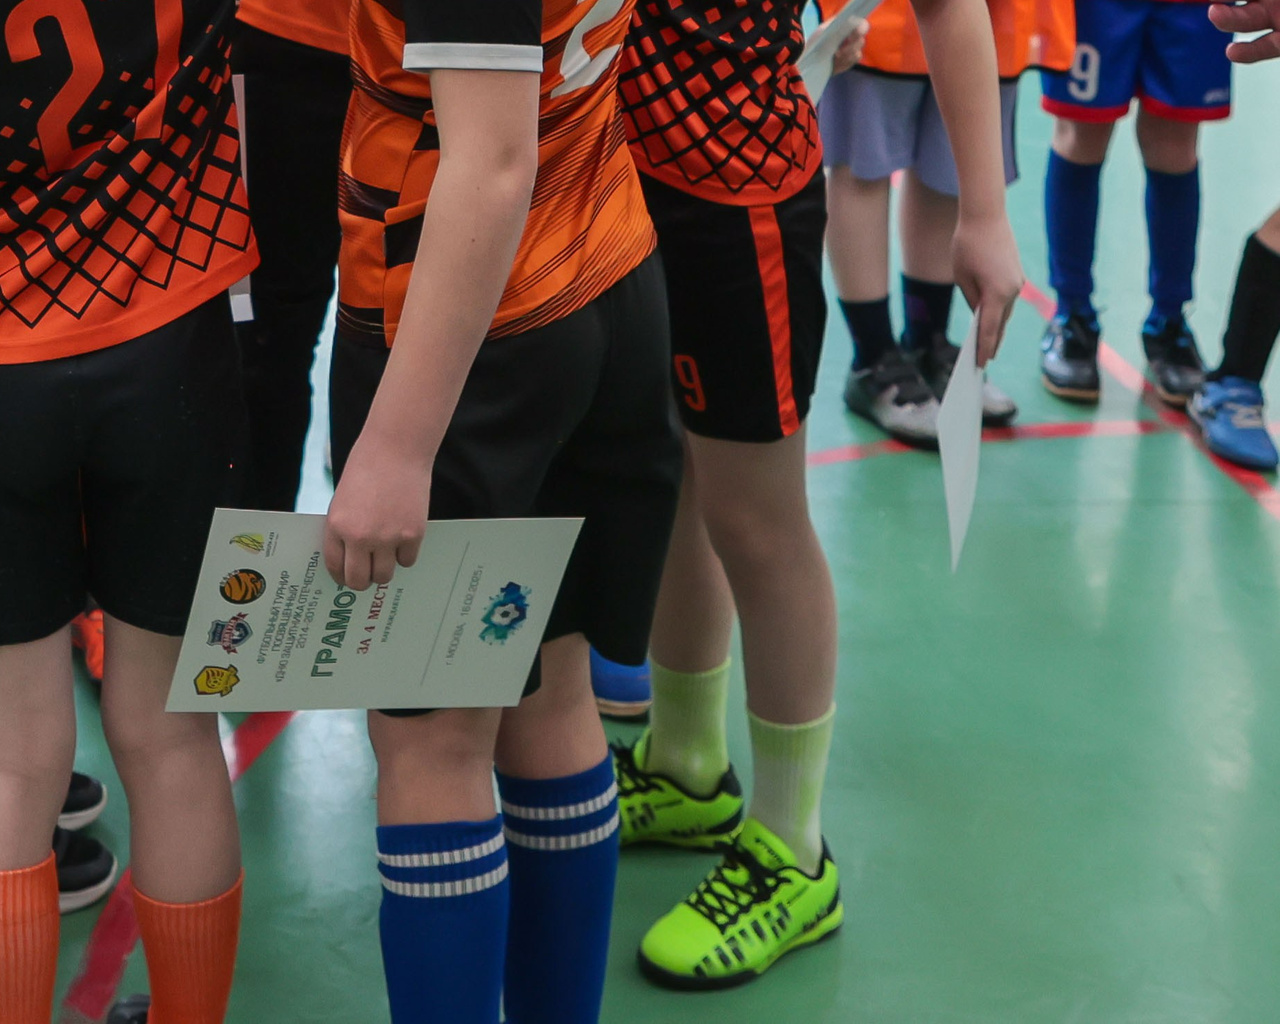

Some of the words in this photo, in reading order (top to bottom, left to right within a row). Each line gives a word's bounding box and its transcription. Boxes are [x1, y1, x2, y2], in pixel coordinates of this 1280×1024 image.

[1067, 42, 1101, 102] 9
[673, 353, 707, 412] 9
[256, 607, 279, 663] ФУТБОЛЬНЫЙ
[273, 571, 290, 603] ТУРНИР
[271, 585, 298, 650] ПОСВЯЩЕННЫЙ
[281, 605, 305, 657] ЗАЩИТНИКА
[298, 552, 320, 602] ОТЕЧЕСТВА»
[296, 601, 317, 647] 2014-2015
[310, 584, 359, 676] ГРАМО
[356, 639, 371, 653] ЗА
[368, 583, 388, 618] МЕСТ
